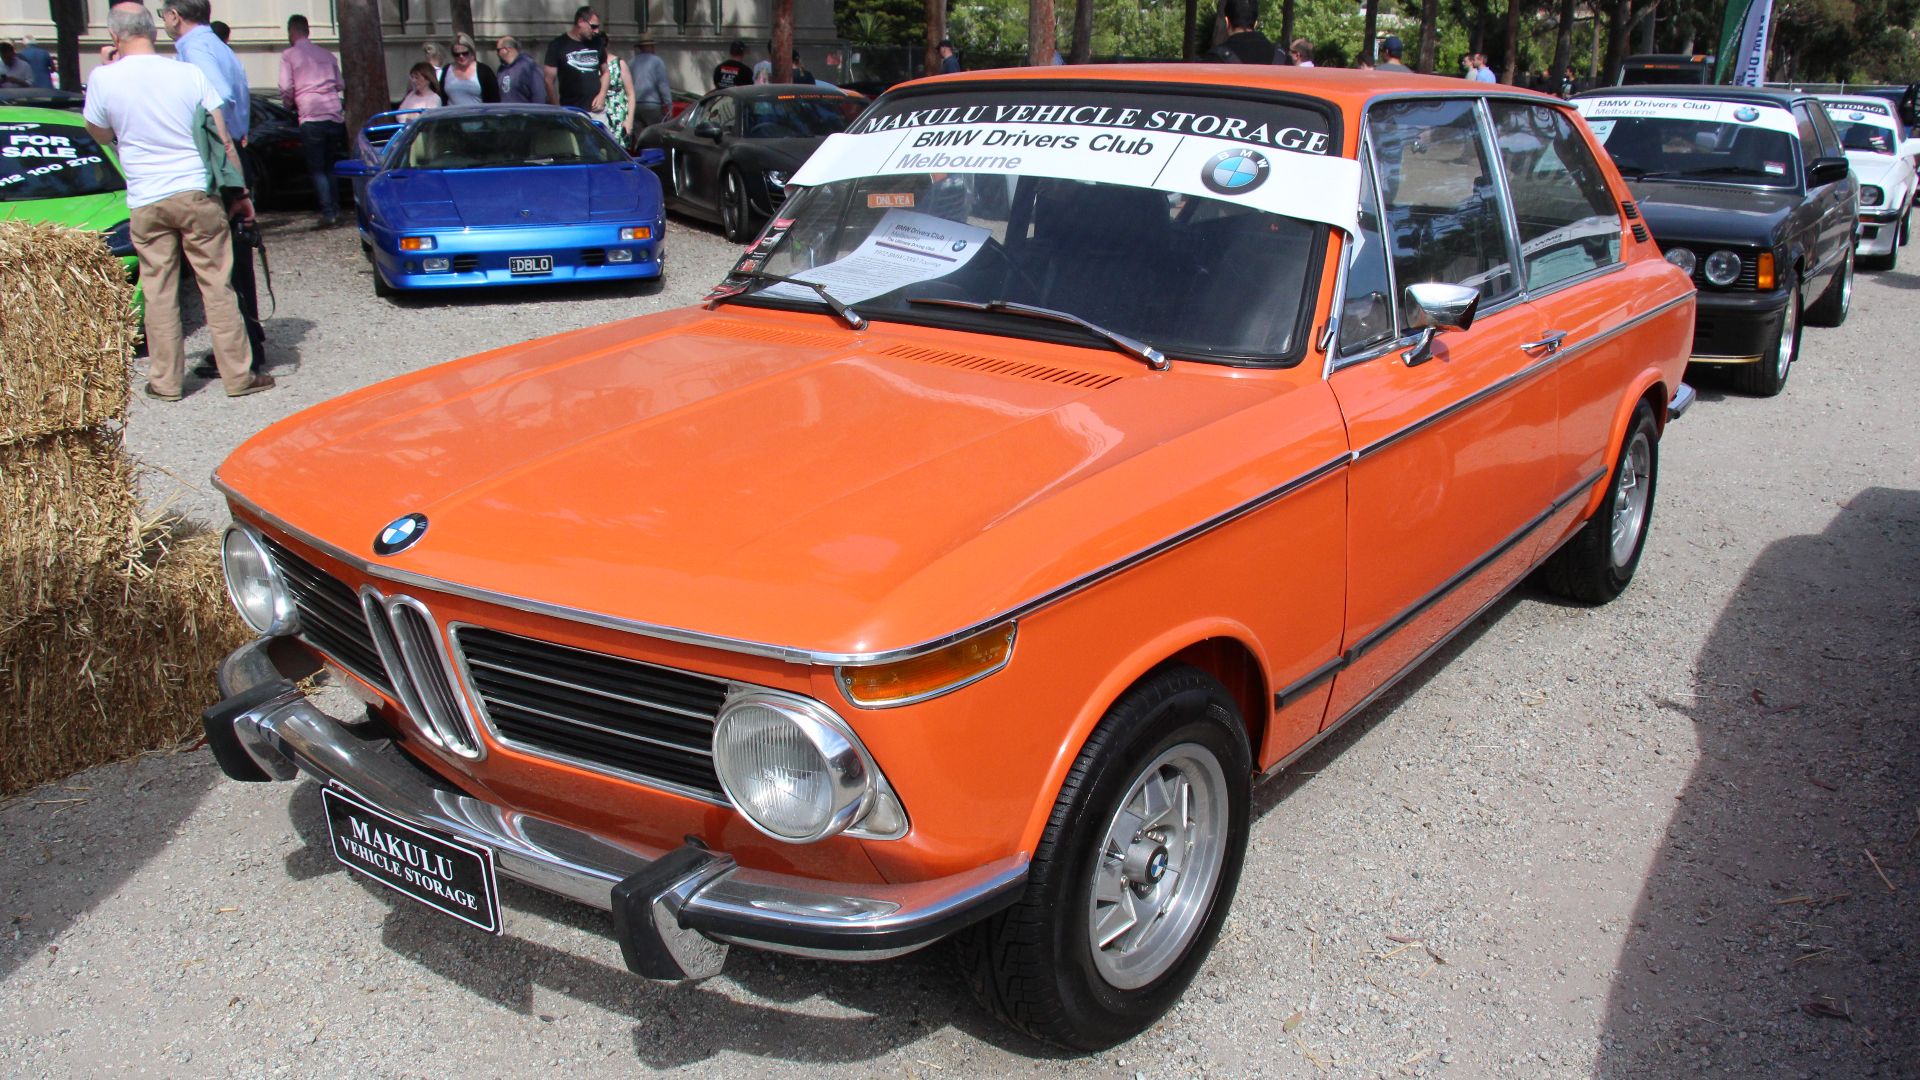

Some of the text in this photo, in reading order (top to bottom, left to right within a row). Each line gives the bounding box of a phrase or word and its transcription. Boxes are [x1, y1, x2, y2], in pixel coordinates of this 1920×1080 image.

[1594, 108, 1657, 116] Melbourne
[1597, 99, 1712, 111] BMW Drivers Club
[1836, 102, 1886, 115] STORAGE
[862, 105, 1330, 155] MAKULU VEHICLE STORAGE
[10, 134, 71, 147] FOR
[911, 129, 1154, 156] BMW Drivers Club
[1, 146, 78, 158] SALE
[895, 152, 1022, 170] Melbourne
[26, 163, 64, 176] 100
[66, 155, 103, 168] 270
[348, 815, 454, 881] MAKULU
[340, 835, 478, 911] VEHICLE STORAGE
